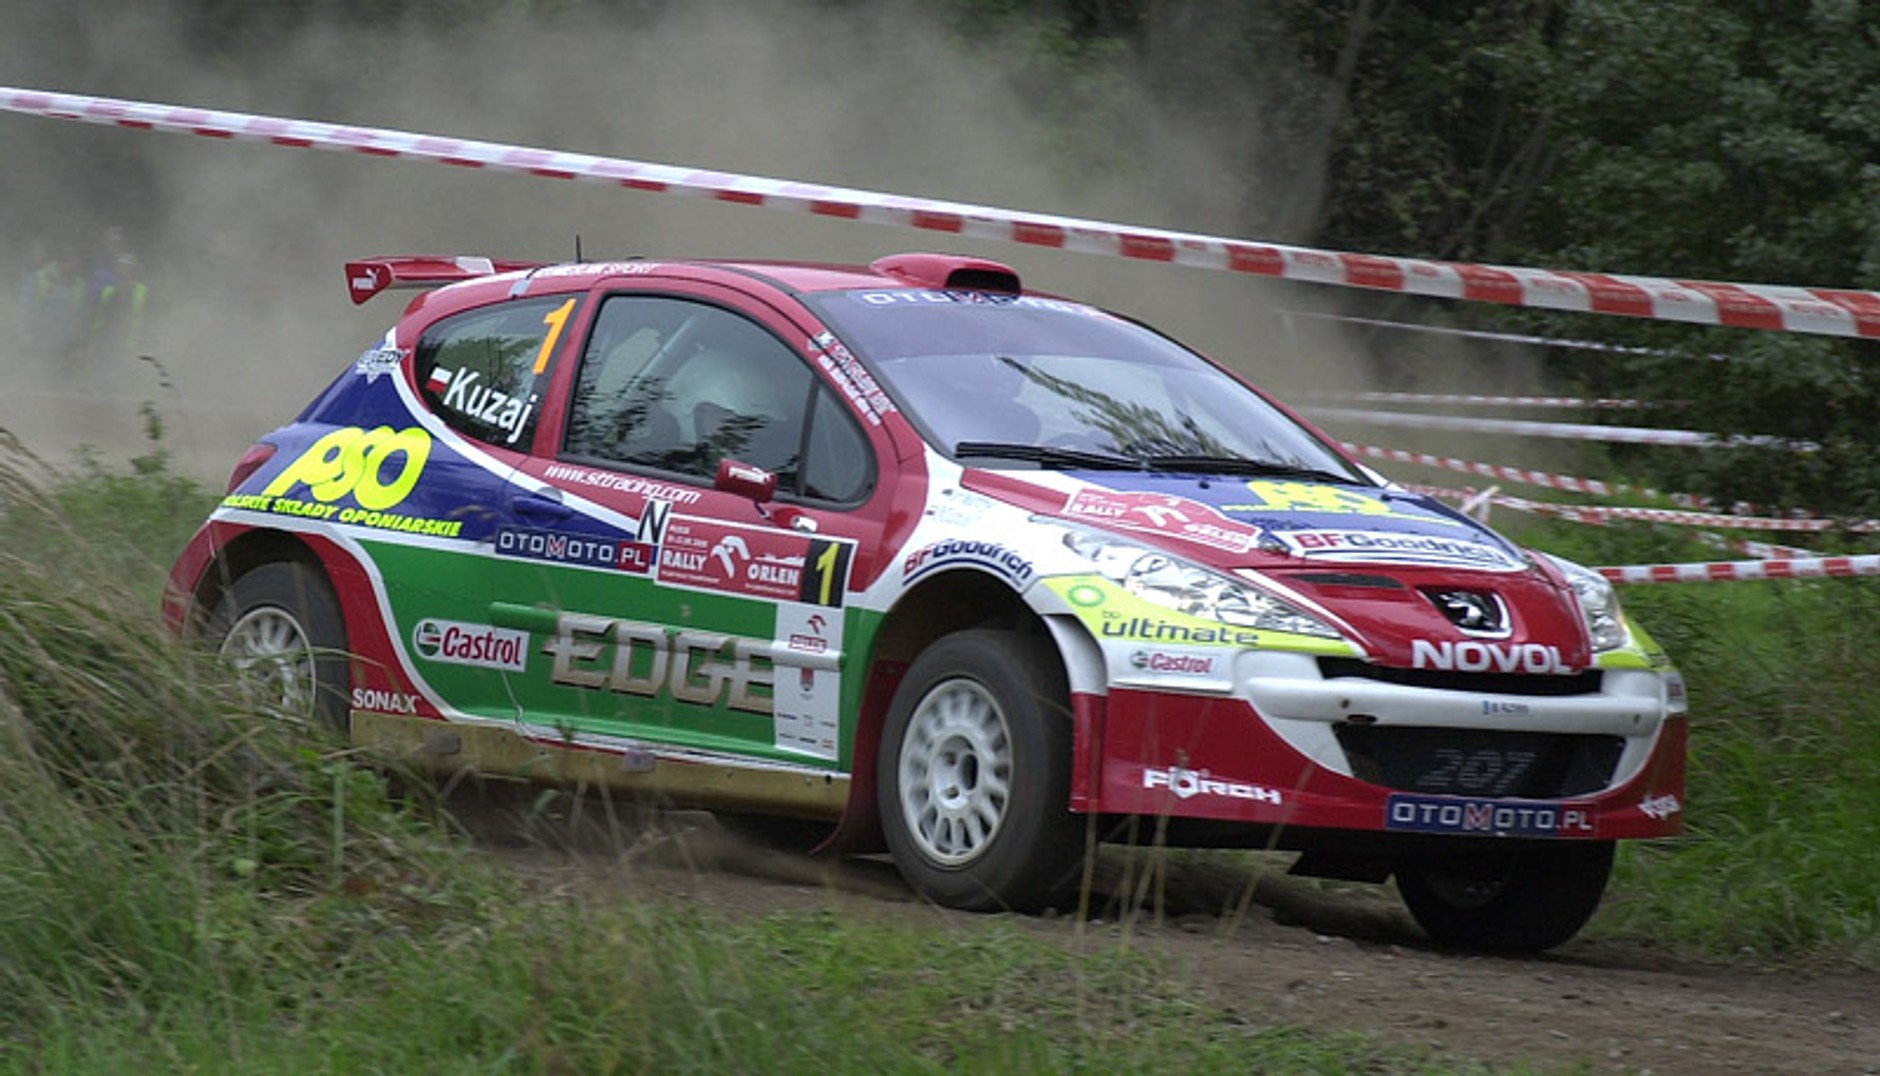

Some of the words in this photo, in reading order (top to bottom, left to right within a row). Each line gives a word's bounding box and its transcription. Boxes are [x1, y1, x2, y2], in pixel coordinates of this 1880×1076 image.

[532, 298, 577, 375] 1
[442, 366, 539, 443] Kuzaj
[261, 425, 433, 511] PSO
[338, 507, 463, 538] OPONIARSKIE
[636, 500, 672, 544] N
[499, 531, 647, 567] OTOMOTO.PL
[662, 549, 707, 572] RALLY
[903, 538, 1034, 580] BFGoodrich
[747, 563, 799, 586] ORLEN
[816, 542, 841, 606] 1
[441, 626, 522, 667] Castrol
[1101, 617, 1260, 645] ultimate
[543, 611, 775, 714] EDGE
[1150, 653, 1215, 674] Castrol
[1411, 639, 1573, 676] NOVOL
[352, 687, 418, 714] SONAX
[1416, 748, 1537, 793] 207
[1391, 801, 1595, 833] OTOMOTO.PL
